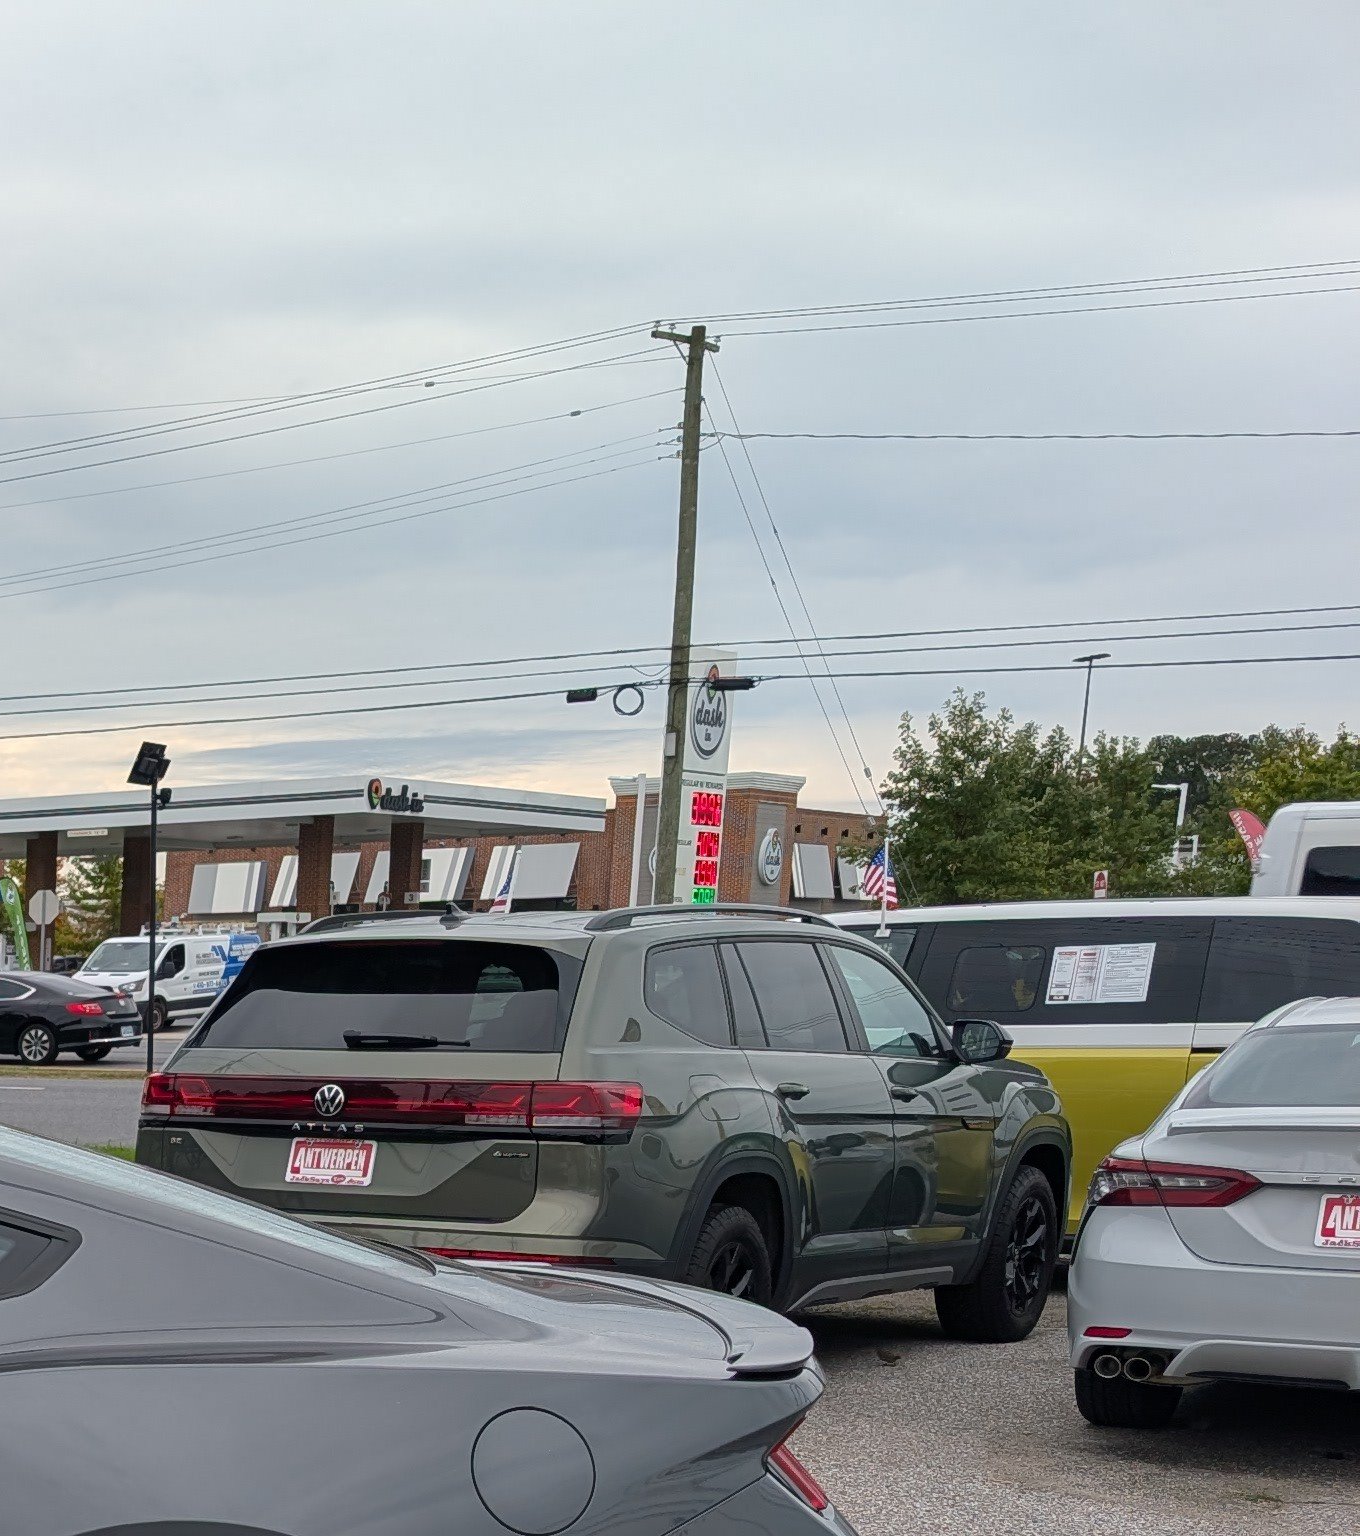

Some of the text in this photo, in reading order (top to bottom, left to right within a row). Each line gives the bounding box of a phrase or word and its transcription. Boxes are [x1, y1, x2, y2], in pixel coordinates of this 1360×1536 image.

[695, 697, 723, 728] dash
[291, 1122, 364, 1133] ATLAS
[293, 1147, 367, 1172] ANTWERPEN
